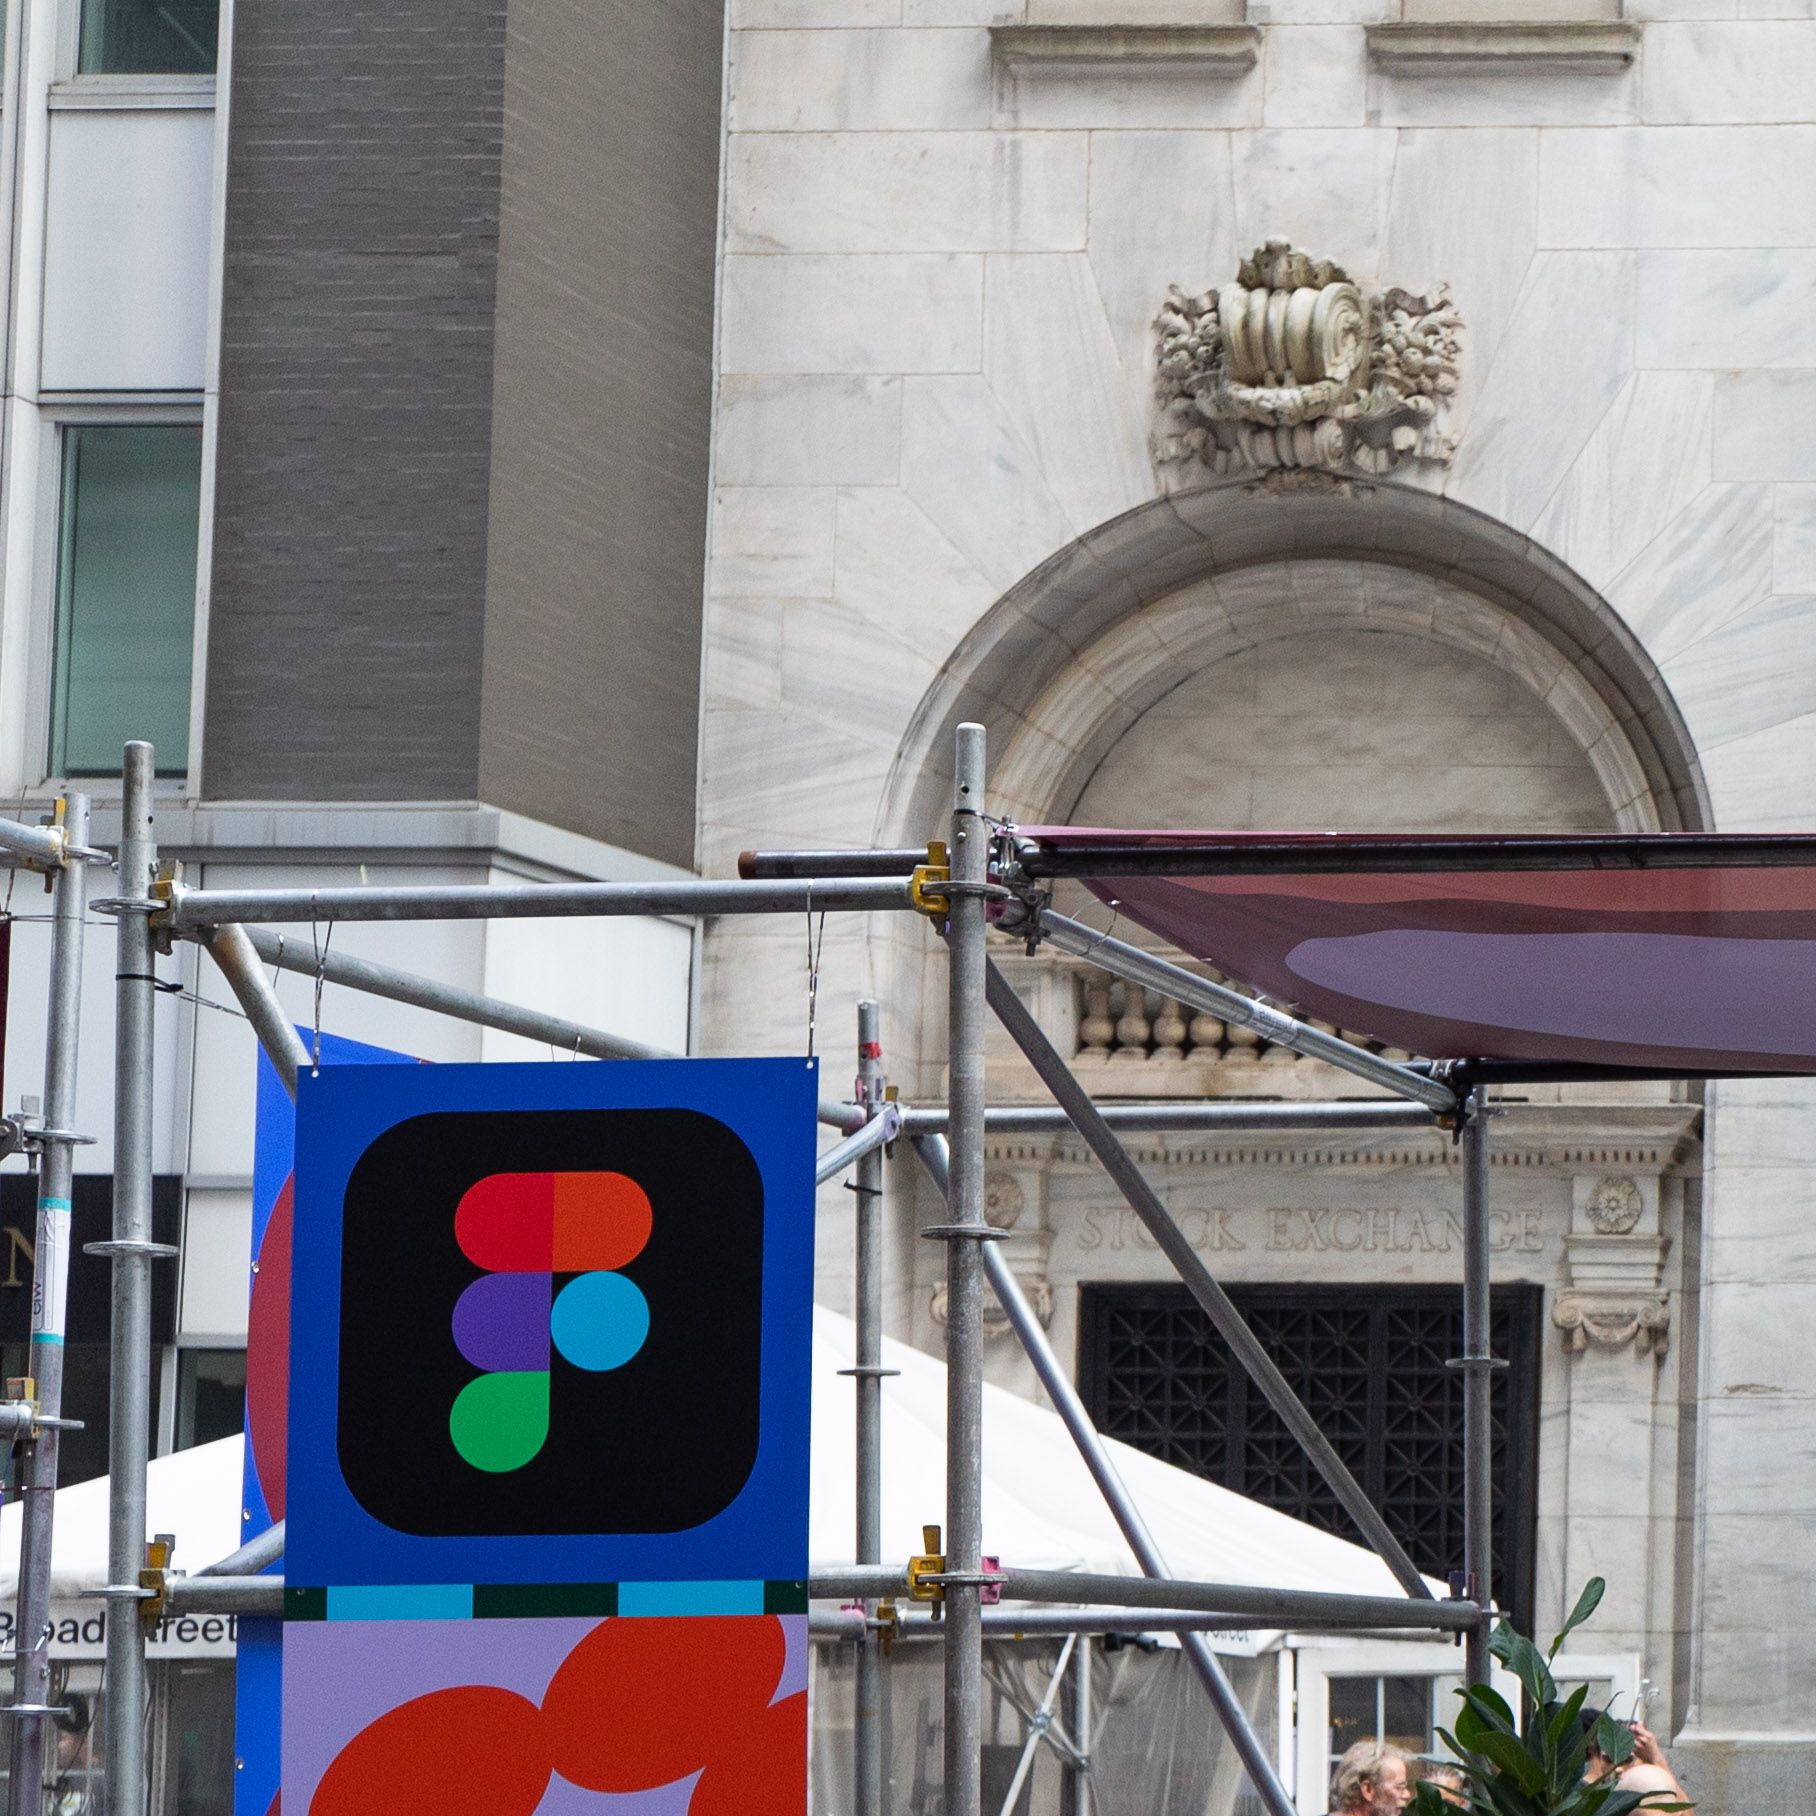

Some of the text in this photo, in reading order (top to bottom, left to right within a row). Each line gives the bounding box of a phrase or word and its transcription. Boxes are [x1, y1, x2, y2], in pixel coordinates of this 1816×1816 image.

[1264, 1206, 1545, 1253] EXCHANGE
[0, 1611, 237, 1644] Bad reet
